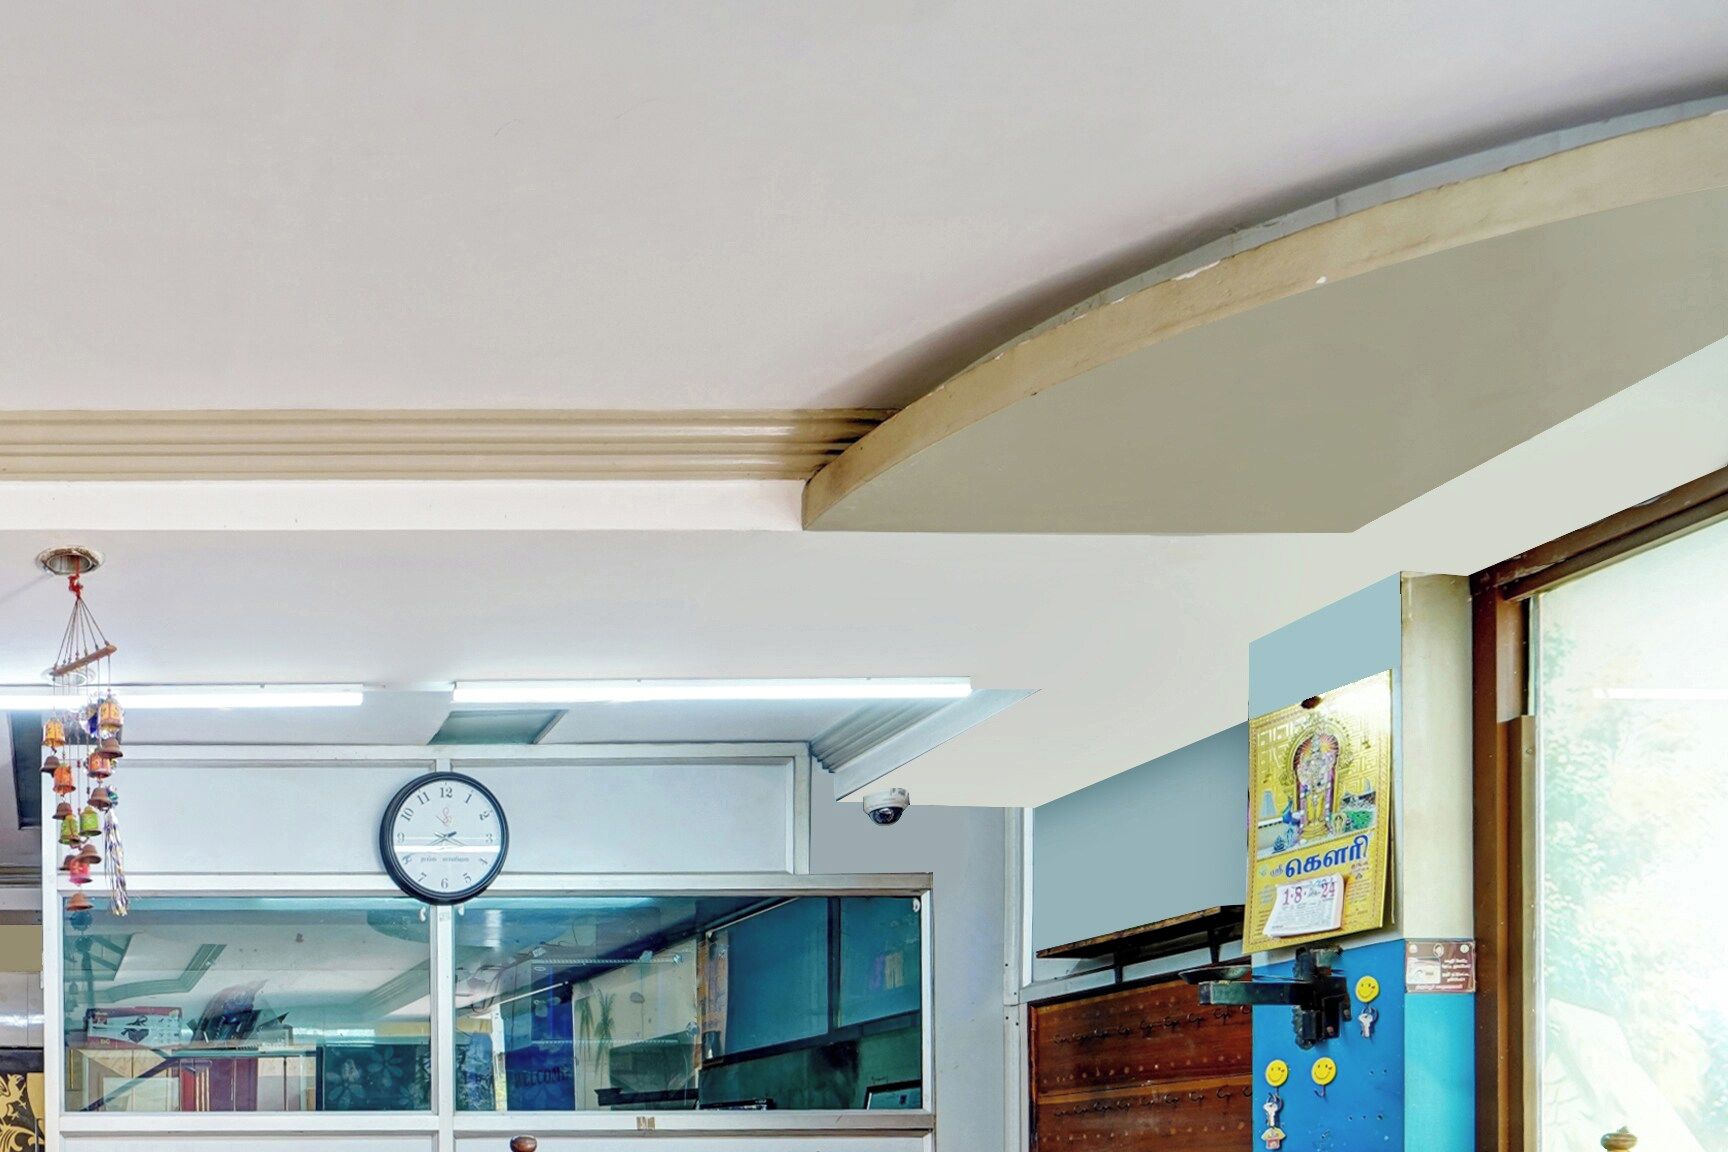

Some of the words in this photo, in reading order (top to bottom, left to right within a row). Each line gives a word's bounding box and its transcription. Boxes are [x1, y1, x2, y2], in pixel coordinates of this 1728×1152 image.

[440, 787, 452, 798] 12
[417, 792, 430, 805] 11
[465, 794, 472, 804] 1
[401, 808, 414, 822] 10
[480, 810, 490, 820] 2
[440, 878, 448, 889] 6
[462, 872, 472, 884] 5
